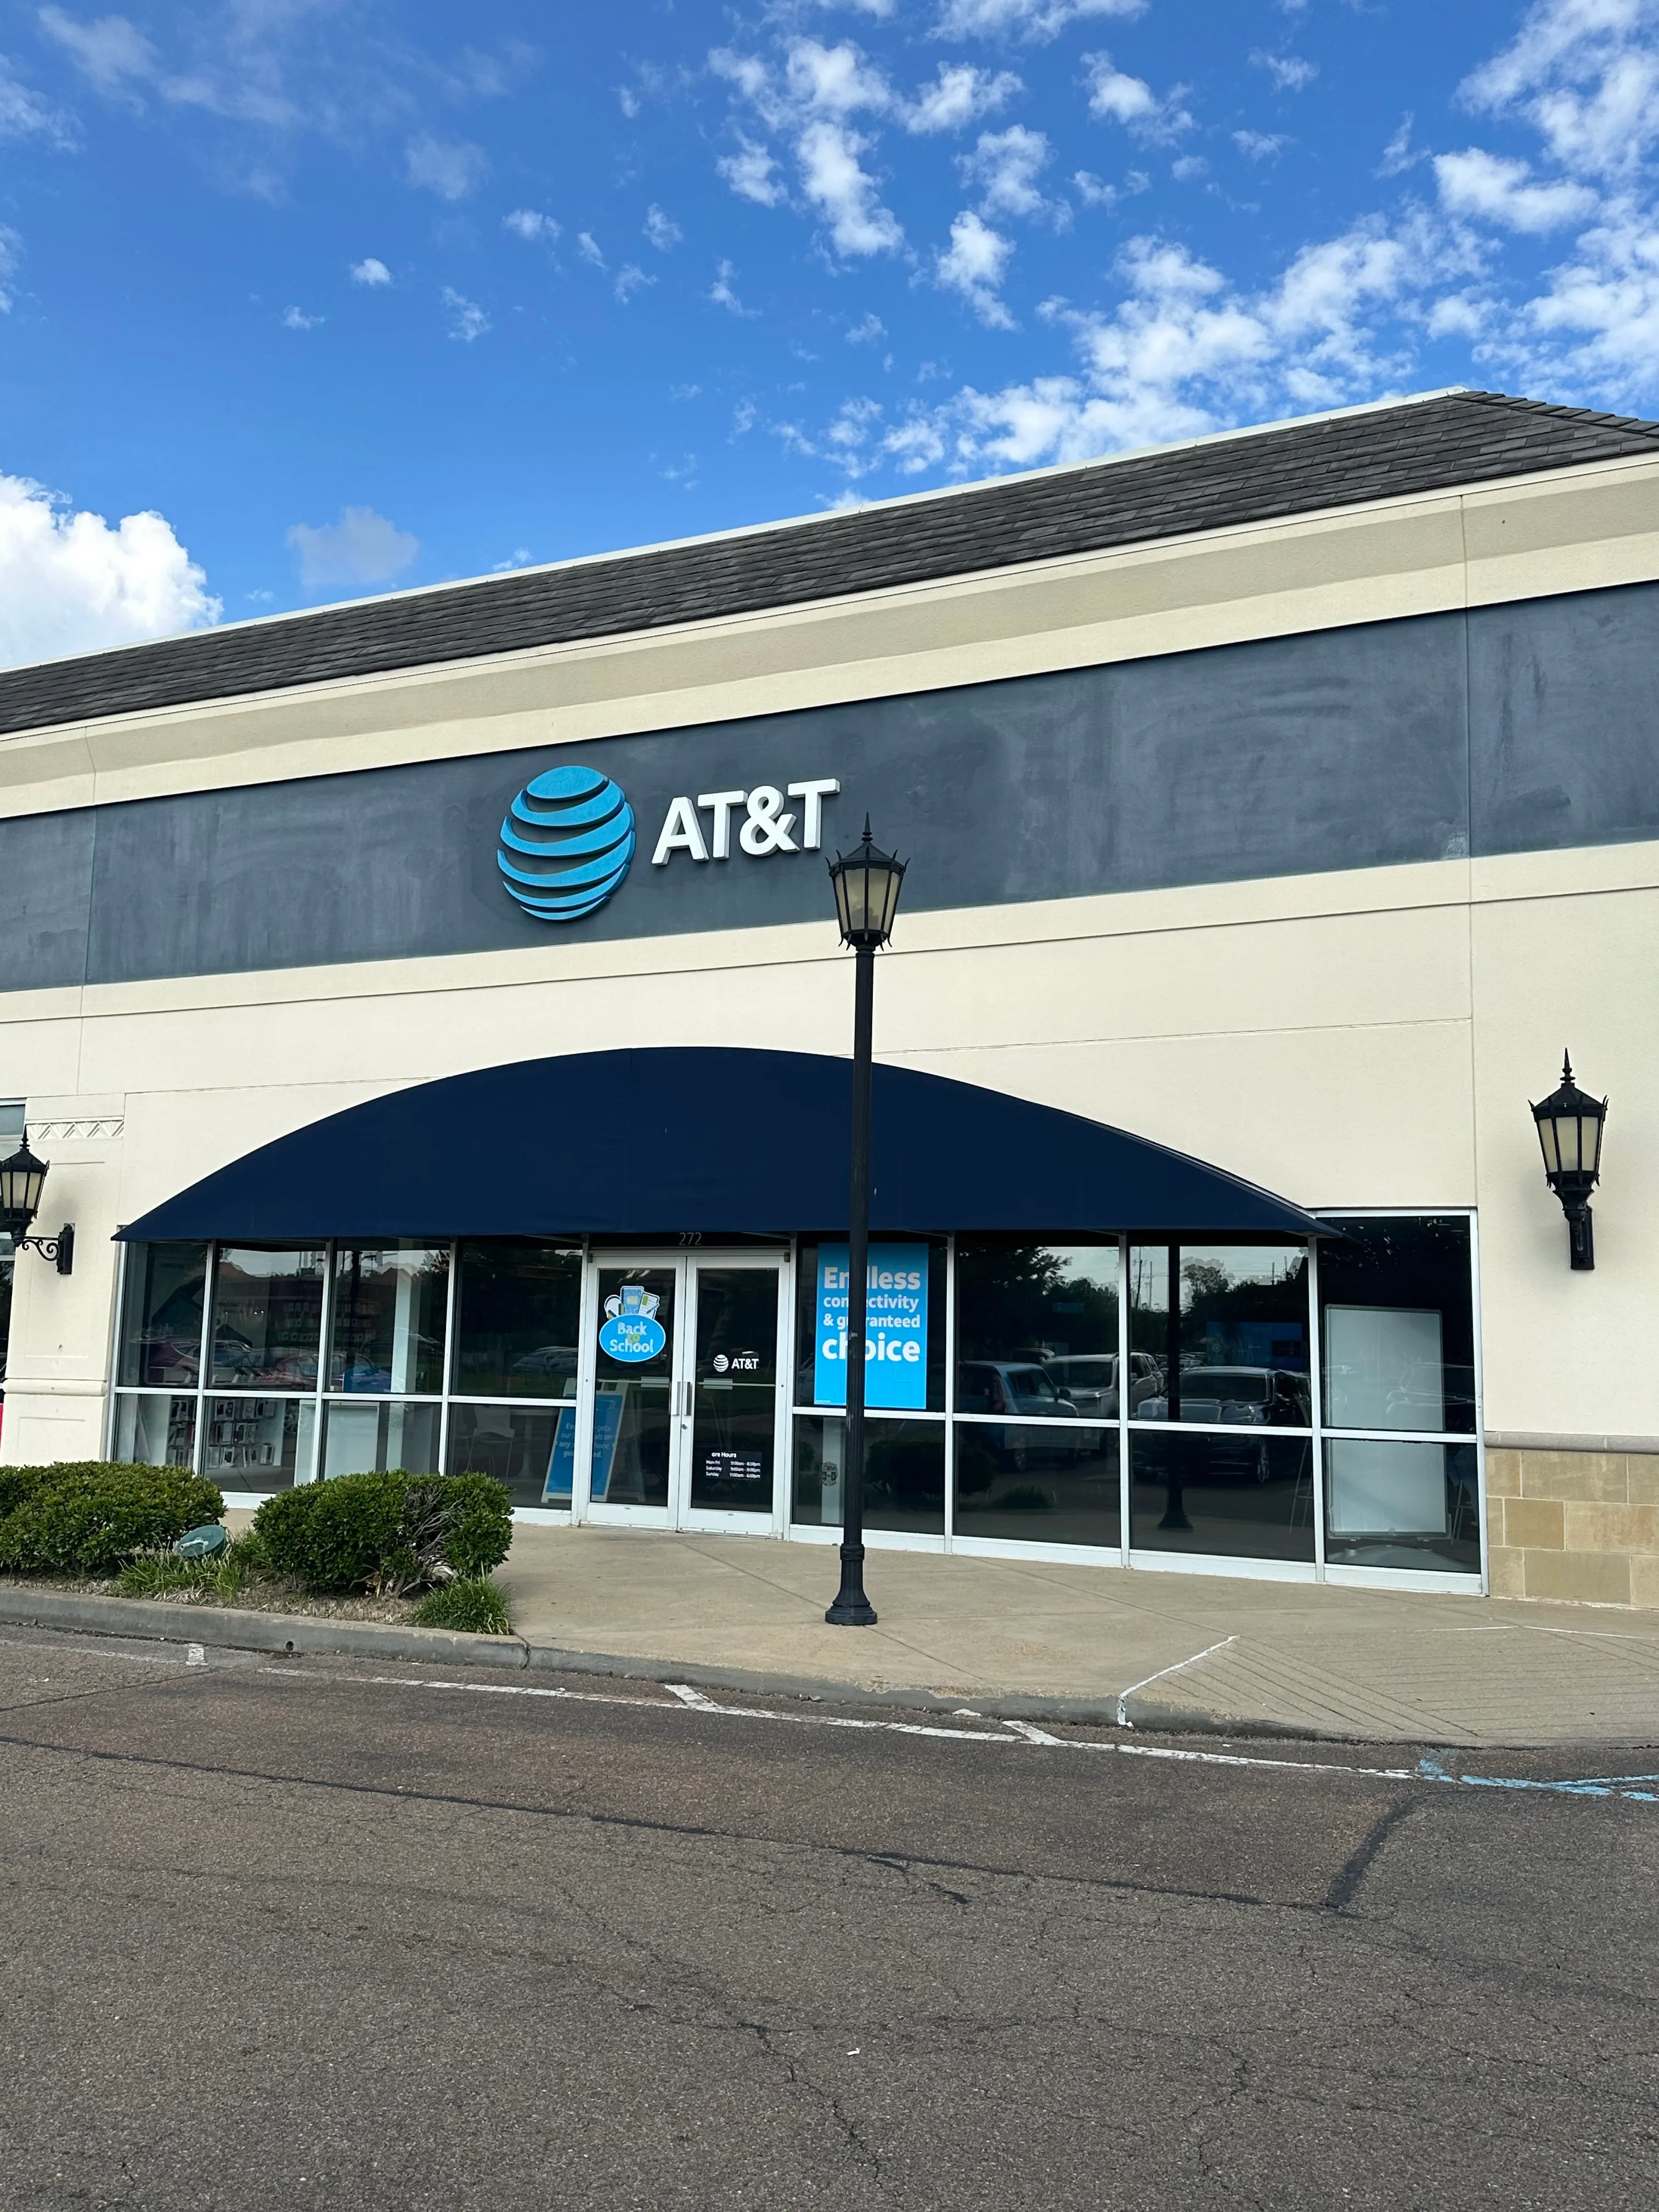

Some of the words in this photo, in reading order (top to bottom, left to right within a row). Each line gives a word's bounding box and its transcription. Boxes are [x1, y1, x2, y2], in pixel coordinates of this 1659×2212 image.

[652, 778, 840, 866] AT&T
[679, 1232, 702, 1245] 272
[824, 1266, 921, 1290] Enless
[823, 1294, 919, 1313] conctivity
[823, 1313, 834, 1326] &
[618, 1321, 647, 1335] Back
[610, 1339, 654, 1353] School
[627, 1334, 640, 1344] to
[731, 1358, 759, 1370] AT&T
